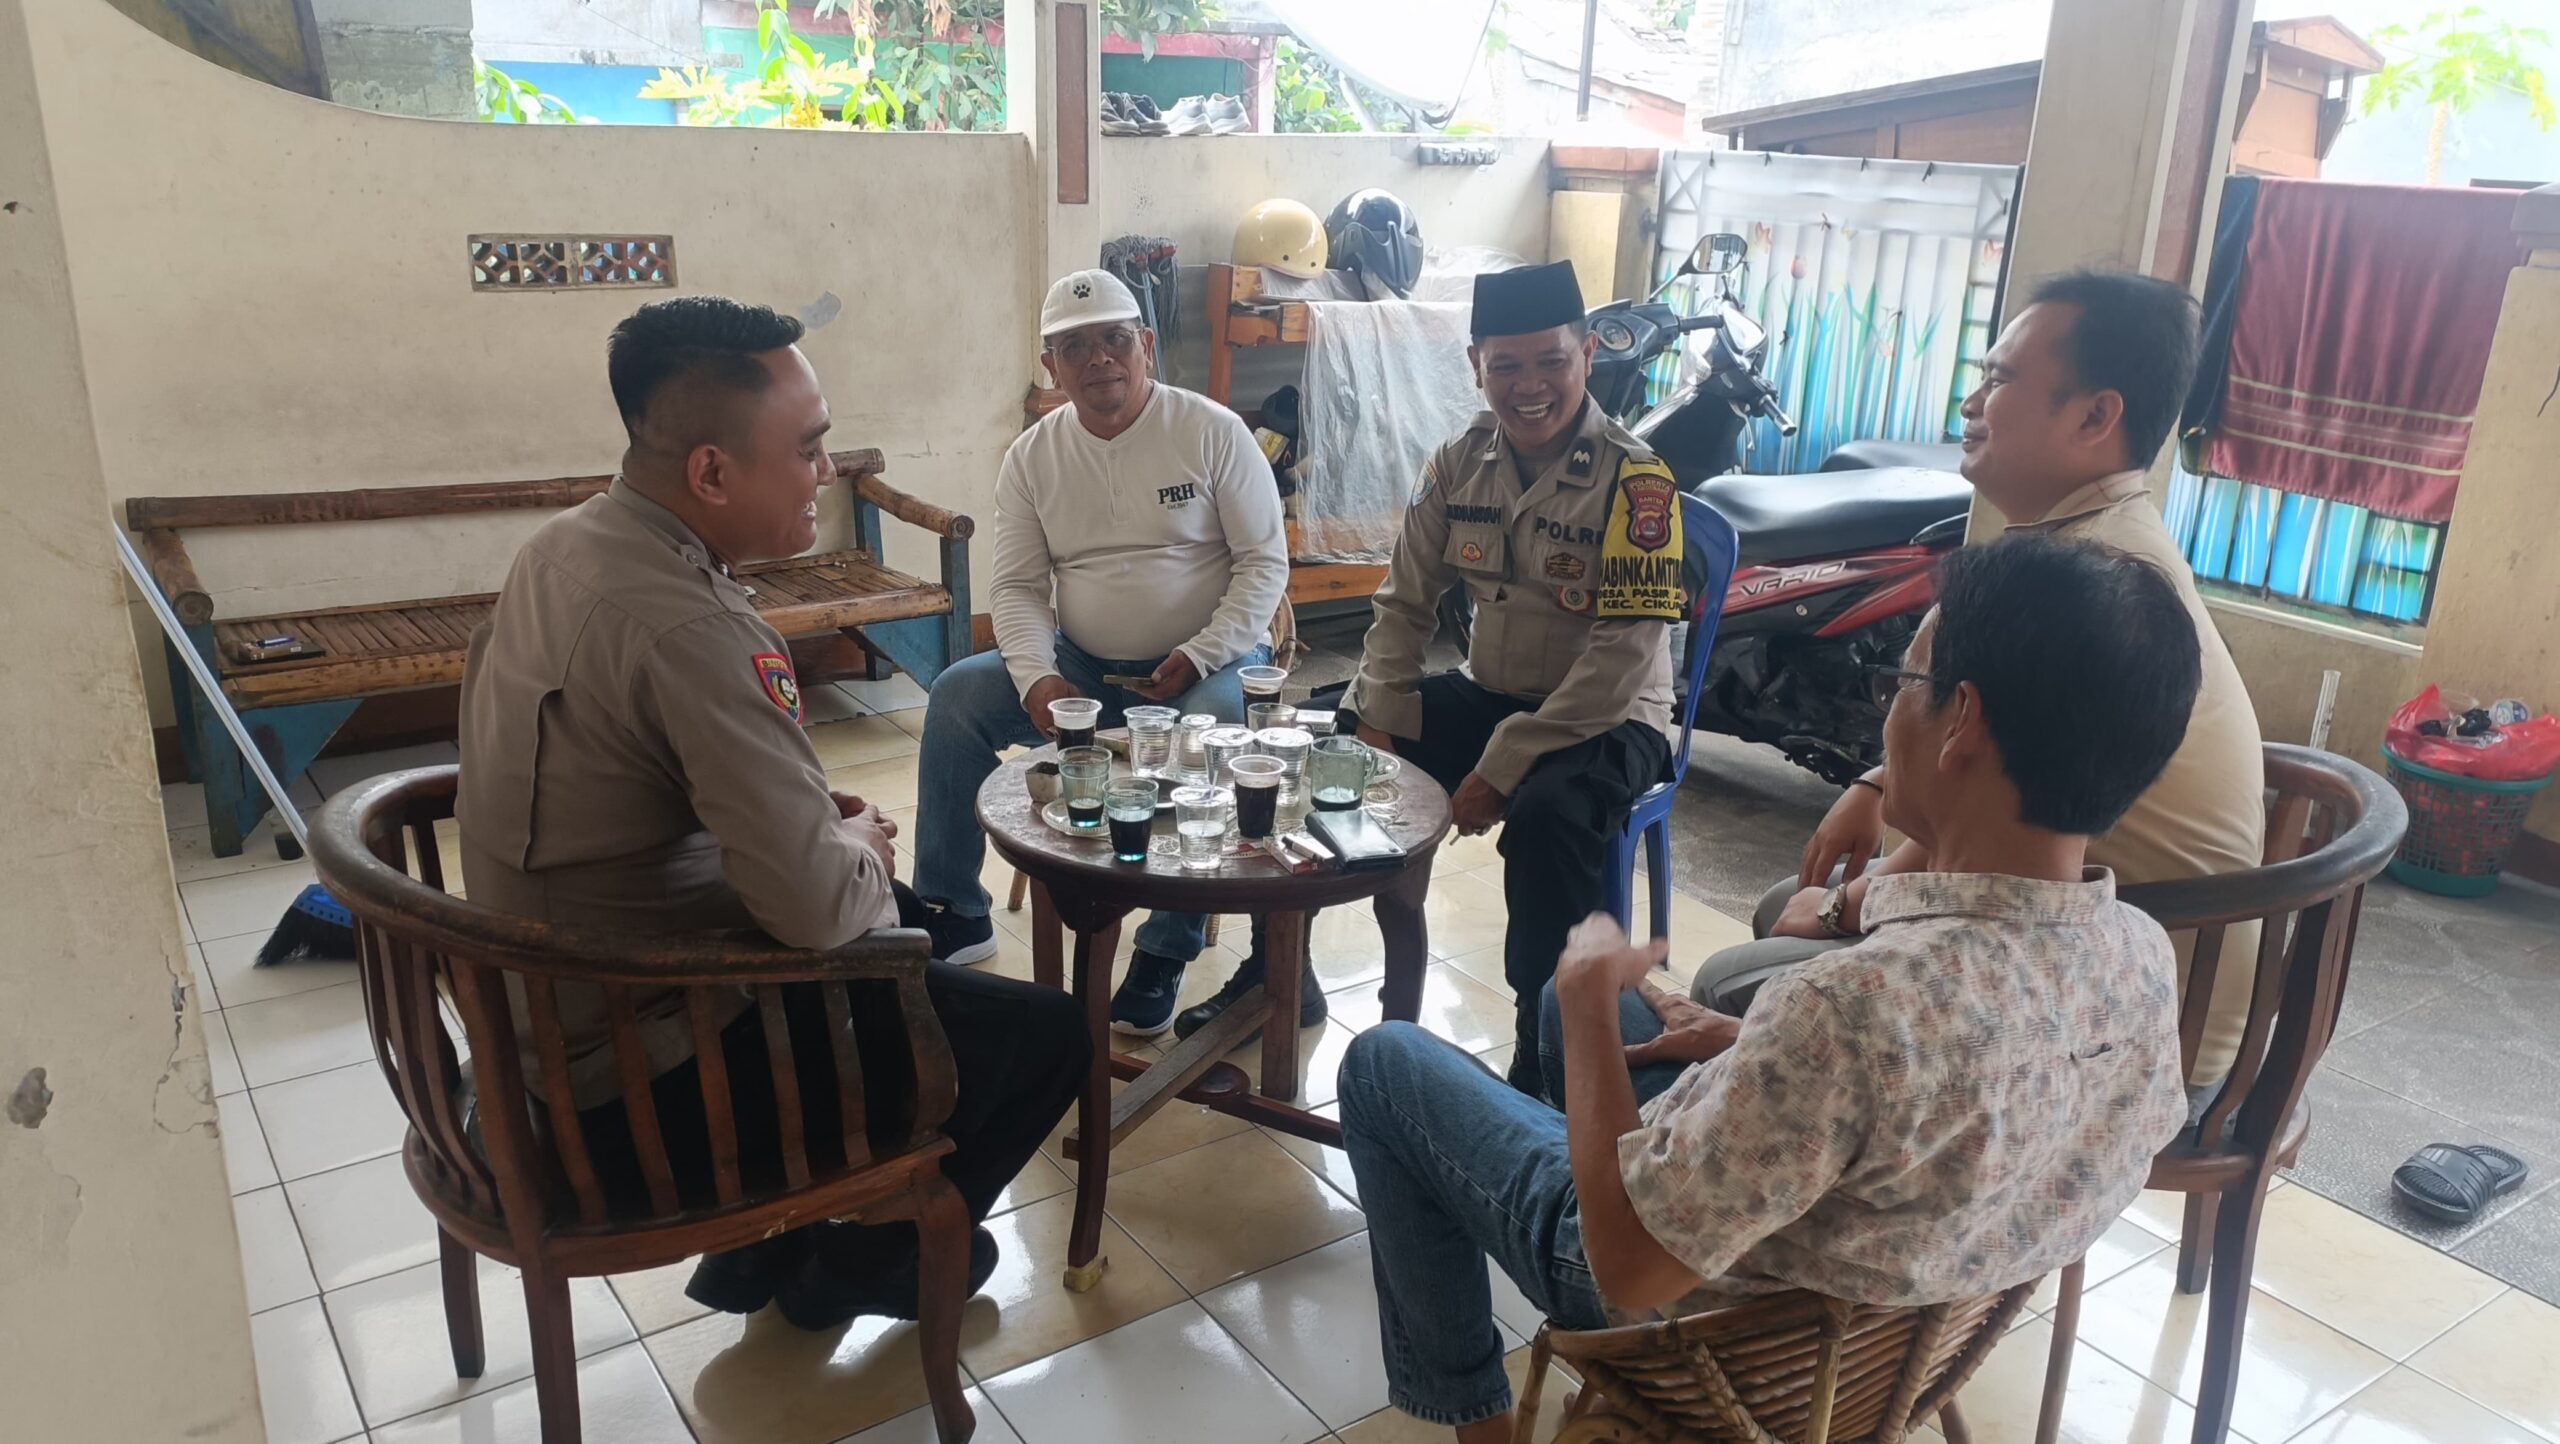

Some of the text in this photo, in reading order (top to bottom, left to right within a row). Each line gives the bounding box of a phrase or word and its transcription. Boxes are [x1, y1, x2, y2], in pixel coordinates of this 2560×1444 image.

[1157, 483, 1196, 505] PRH
[1535, 516, 1603, 545] POLRI
[1740, 561, 1847, 596] VARIO
[1632, 589, 1669, 599] PASIR
